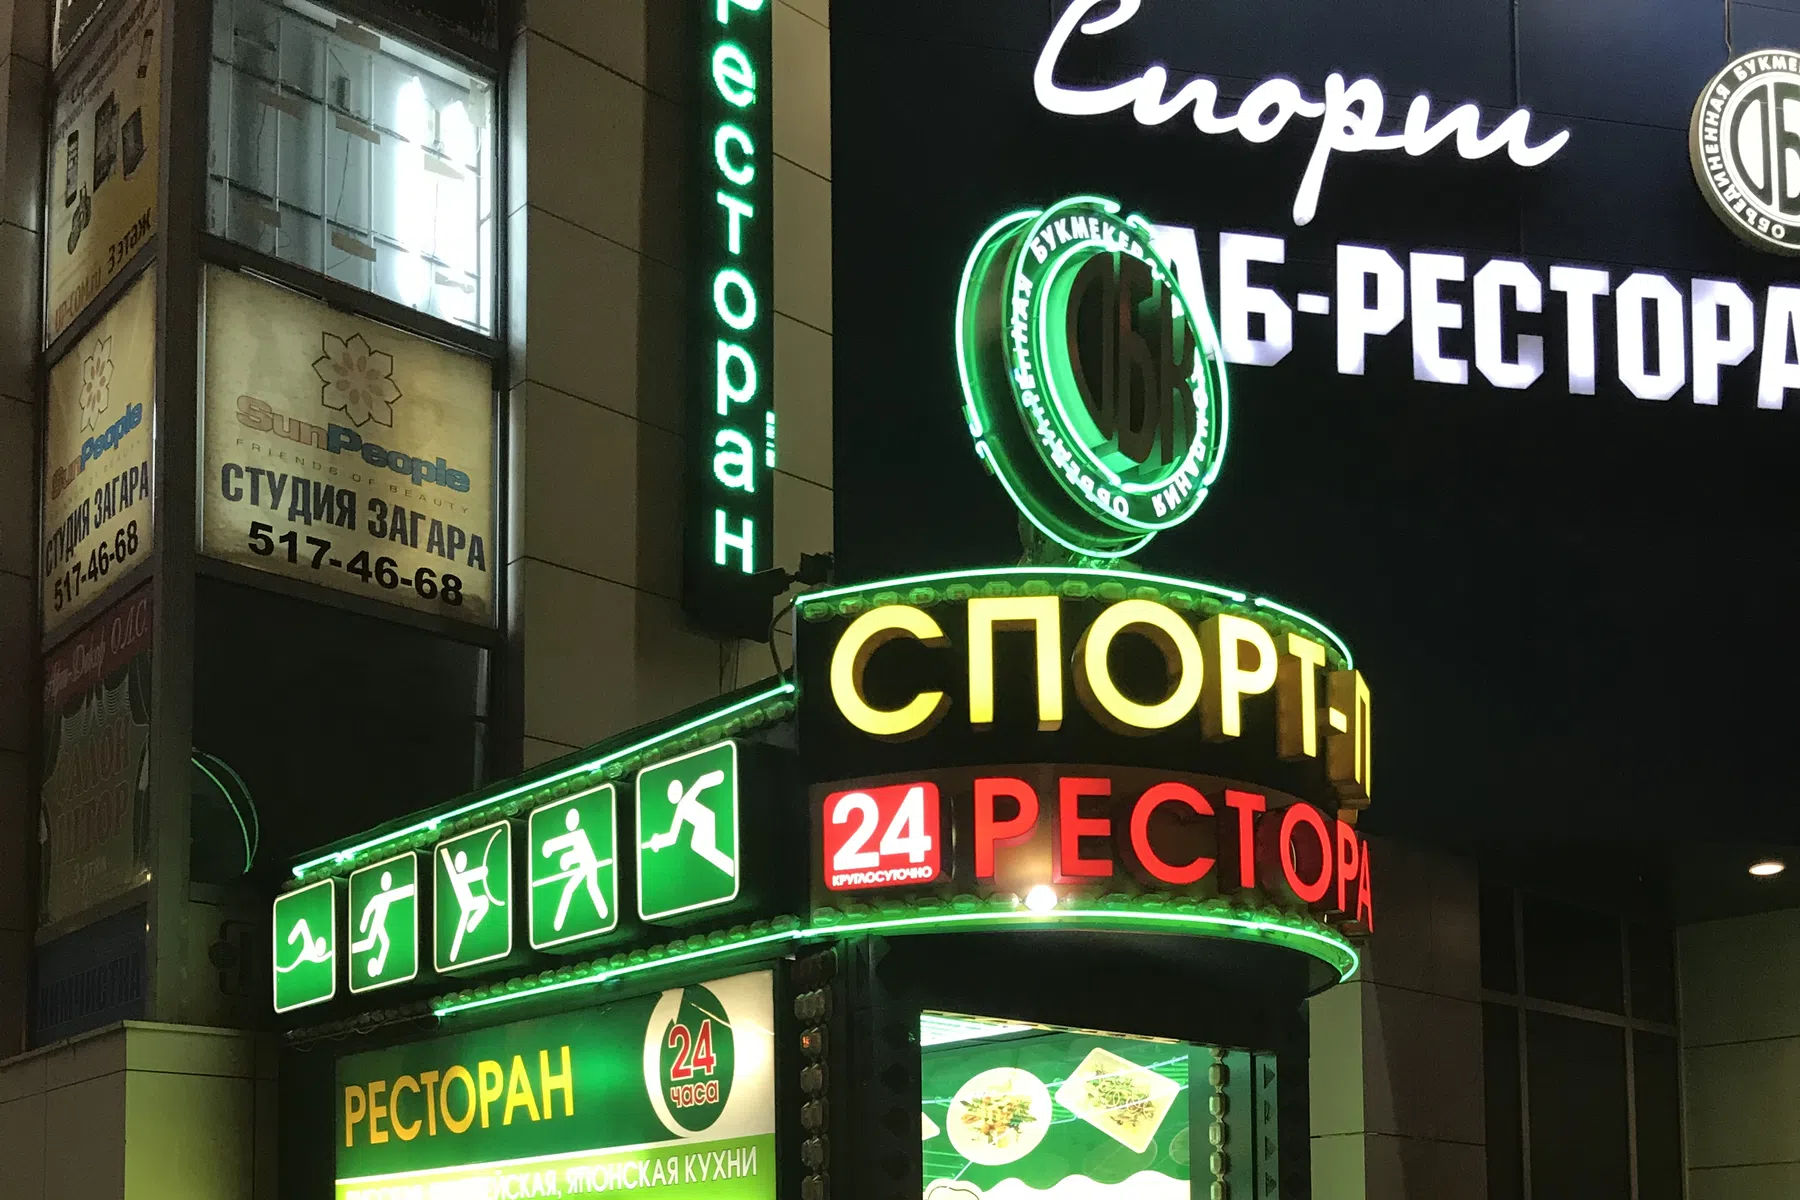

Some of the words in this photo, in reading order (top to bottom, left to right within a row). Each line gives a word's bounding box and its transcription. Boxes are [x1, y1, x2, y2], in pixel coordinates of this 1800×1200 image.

[1733, 54, 1800, 84] БУКМЕ
[1703, 83, 1787, 240] ОБЪЕДИНЕННАЯ
[45, 496, 91, 577] СТУДИЯ
[94, 460, 149, 529] ЗАГАРА
[221, 462, 357, 531] СТУДИЯ
[367, 497, 487, 572] ЗАГАРА
[389, 484, 469, 514] BEAUTY
[54, 519, 139, 612] 517-46-68
[248, 520, 463, 606] 517-46-68
[832, 787, 932, 871] 24
[832, 866, 932, 887] КРУГЛОСУТОЧНО
[667, 1019, 717, 1081] 24
[344, 1045, 574, 1148] РЕСТОРАН
[669, 1079, 719, 1109] часа
[566, 1156, 679, 1195] ЯПОНСКАЯ
[684, 1146, 757, 1184] КУХНИ
